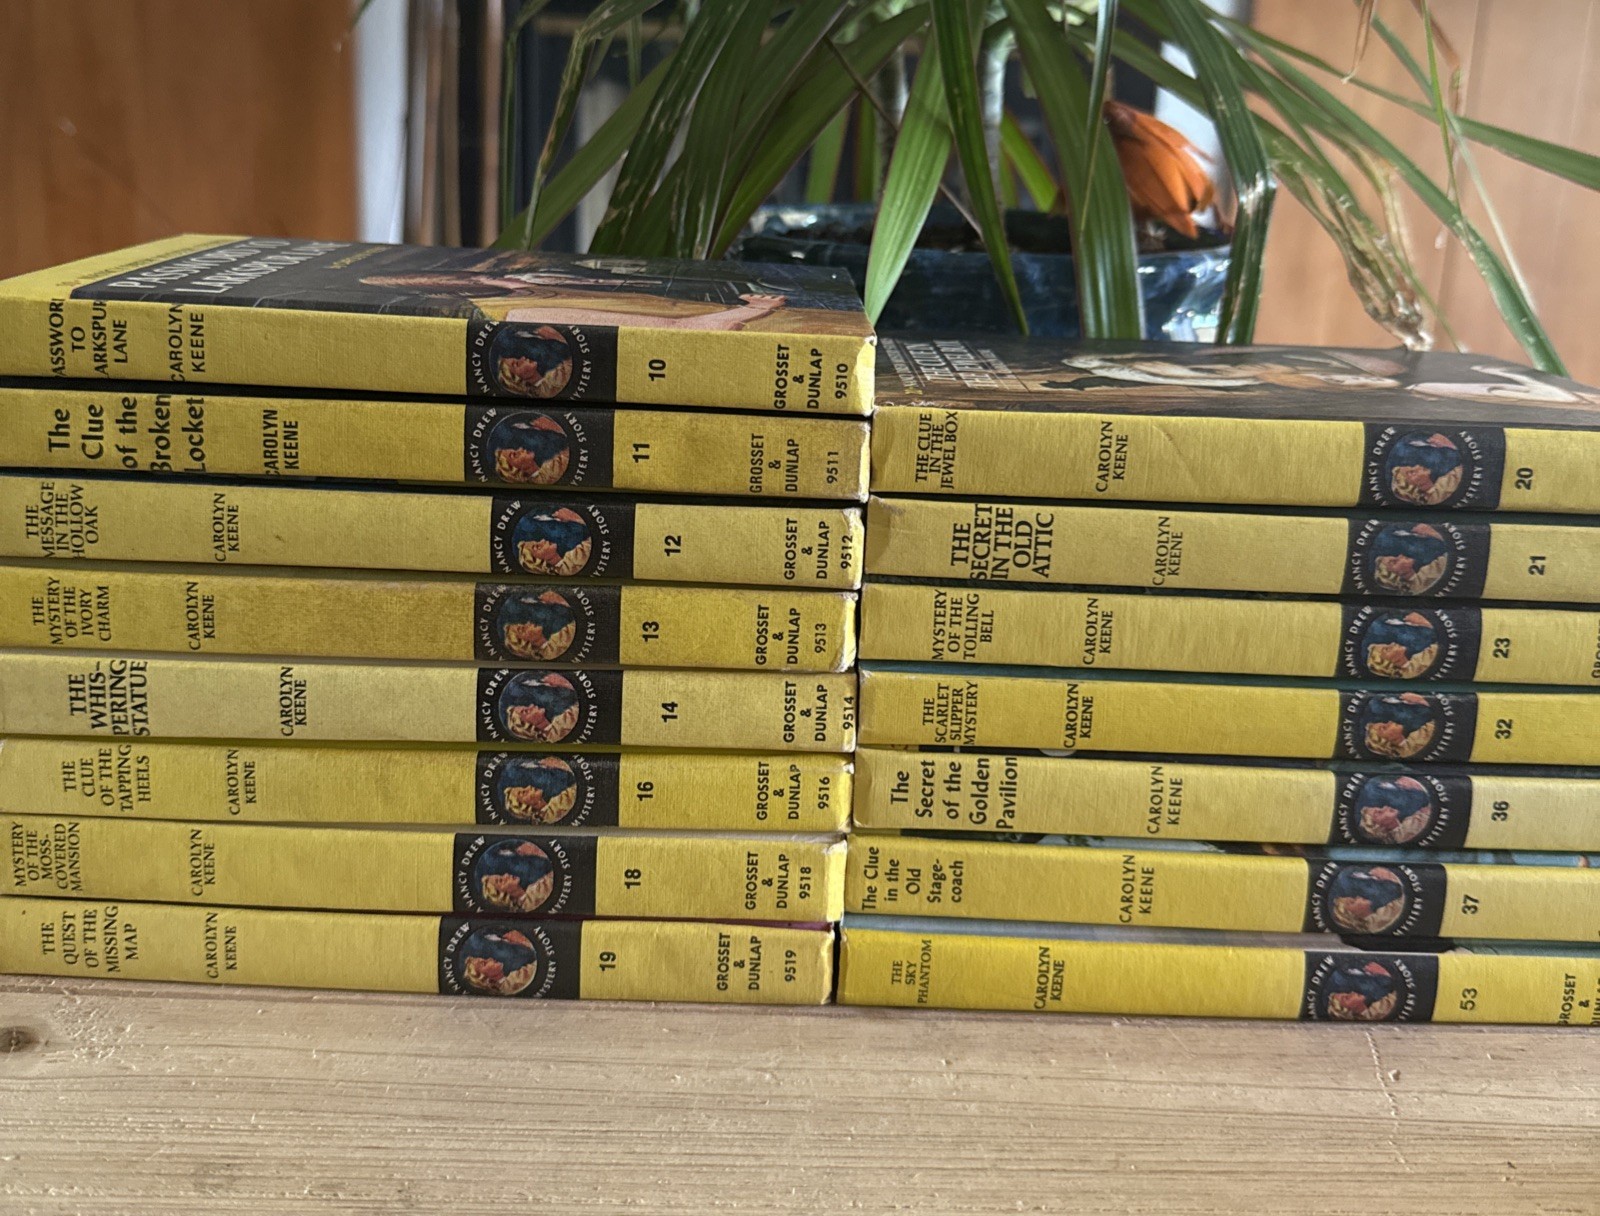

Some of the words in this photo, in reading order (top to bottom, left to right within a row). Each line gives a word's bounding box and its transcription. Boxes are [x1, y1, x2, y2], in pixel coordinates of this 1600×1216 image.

[71, 326, 86, 353] TO
[114, 319, 128, 364] LANE
[191, 312, 205, 372] KEENE
[648, 359, 666, 382] 10
[774, 344, 789, 409] GROSSET
[807, 348, 823, 409] DUNLAP
[835, 363, 848, 399] 9510
[48, 408, 70, 452] The
[81, 404, 104, 460] Clue
[116, 396, 137, 436] the
[148, 394, 172, 473] Broken
[182, 398, 206, 472] Locket
[917, 413, 932, 451] CLUE
[944, 411, 958, 443] BOX
[115, 443, 138, 469] of
[284, 420, 300, 470] KEENE
[632, 443, 650, 463] 11
[930, 424, 944, 454] THE
[1095, 421, 1113, 492] CAROLYN
[1112, 434, 1128, 480] KEENE
[750, 433, 764, 493] GROSSET
[785, 438, 799, 492] DUNLAP
[827, 452, 839, 484] 9511
[915, 453, 929, 483] THE
[929, 457, 941, 474] IN
[940, 445, 956, 489] JEWEL
[1515, 467, 1534, 490] 20
[26, 505, 39, 539] THE
[56, 493, 69, 529] THE
[85, 505, 99, 544] OAK
[214, 493, 226, 562] CAROLYN
[228, 504, 240, 552] KEENE
[498, 500, 522, 530] DREW
[586, 504, 610, 534] STORY
[994, 508, 1014, 550] THE
[56, 532, 69, 550] IN
[494, 535, 512, 573] NANCY
[664, 535, 682, 556] 12
[784, 518, 798, 580] GROSSET
[816, 521, 830, 579] DUNLAP
[840, 535, 853, 569] 9512
[951, 522, 971, 566] THE
[970, 503, 992, 580] SECRET
[1012, 520, 1033, 569] OLD
[1032, 513, 1054, 578] ATTIC
[1152, 516, 1170, 586] CAROLYN
[1168, 532, 1183, 576] KEENE
[990, 558, 1010, 580] IN
[1528, 554, 1546, 576] 21
[32, 597, 45, 626] THE
[48, 577, 63, 644] MYSTERY
[64, 586, 76, 615] THE
[80, 590, 94, 636] IVORY
[97, 586, 111, 642] CHARM
[186, 581, 201, 650] CAROLYN
[202, 594, 216, 639] KEENE
[949, 597, 963, 628] THE
[64, 617, 77, 638] OF
[642, 621, 660, 642] 13
[755, 604, 769, 665] GROSSET
[787, 608, 800, 664] DUNLAP
[815, 623, 827, 653] 9513
[932, 589, 948, 660] MYSTERY
[948, 632, 961, 653] OF
[963, 593, 980, 660] TOLLING
[980, 610, 994, 644] BELL
[1082, 598, 1099, 666] CAROLYN
[1099, 610, 1114, 654] KEENE
[1493, 637, 1511, 659] 23
[68, 673, 87, 716] THE
[89, 661, 108, 729] WHIS-
[110, 659, 130, 736] PERING
[131, 660, 150, 737] STATUE
[280, 666, 294, 737] CAROLYN
[294, 679, 307, 726] KEENE
[661, 701, 679, 723] 14
[783, 681, 797, 743] GROSSET
[815, 684, 828, 741] DUNLAP
[843, 696, 855, 730] 9514
[922, 698, 935, 726] THE
[934, 683, 950, 743] SCARLET
[950, 687, 964, 740] SLIPPER
[963, 681, 978, 746] MYSTERY
[1063, 683, 1079, 748] CAROLYN
[1079, 696, 1094, 739] KEENE
[1494, 718, 1513, 740] 32
[62, 760, 76, 792] THE
[80, 758, 96, 797] CLUE
[99, 748, 112, 781] THE
[118, 744, 133, 812] TAPPING
[135, 755, 150, 802] HEELS
[226, 750, 240, 816] CAROLYN
[244, 761, 256, 804] KEENE
[942, 761, 962, 794] the
[100, 786, 115, 806] OF
[637, 780, 654, 801] 16
[756, 761, 770, 820] GROSSET
[788, 764, 801, 819] DUNLAP
[818, 777, 830, 809] 9516
[890, 770, 910, 805] The
[914, 760, 936, 818] Secret
[942, 799, 960, 820] of
[969, 758, 990, 825] Golden
[996, 757, 1018, 830] Pavilion
[1146, 766, 1164, 835] CAROLYN
[1166, 777, 1184, 826] KEENE
[1491, 800, 1510, 822] 36
[12, 822, 27, 887] MYSTERY
[26, 830, 38, 860] THE
[40, 833, 53, 879] MOSS-
[53, 823, 68, 890] COVERED
[68, 822, 83, 891] MANSION
[191, 829, 203, 897] CAROLYN
[203, 842, 216, 886] KEENE
[863, 846, 880, 880] Clue
[27, 862, 40, 881] OF
[624, 868, 642, 890] 18
[745, 851, 759, 910] GROSSET
[776, 854, 790, 909] DUNLAP
[799, 866, 812, 899] 9518
[884, 858, 900, 883] the
[905, 868, 921, 896] Old
[927, 858, 947, 904] Stage-
[950, 860, 964, 904] coach
[1119, 854, 1135, 924] CAROLYN
[1138, 866, 1155, 915] KEENE
[862, 886, 878, 911] The
[884, 886, 899, 902] in
[1462, 894, 1480, 915] 37
[41, 922, 55, 955] THE
[62, 911, 79, 966] QUEST
[82, 909, 98, 944] THE
[104, 905, 121, 973] MISSING
[124, 922, 139, 960] MAP
[203, 912, 219, 979] CAROLYN
[224, 925, 238, 971] KEENE
[82, 948, 99, 968] OF
[599, 951, 617, 971] 19
[717, 932, 731, 991] GROSSET
[748, 936, 762, 990] DUNLAP
[785, 950, 797, 982] 9519
[891, 960, 903, 986] THE
[905, 960, 917, 986] SKY
[918, 939, 932, 1004] PHANTOM
[1034, 946, 1050, 1010] CAROLYN
[1050, 960, 1066, 1001] KEENE
[1459, 987, 1479, 1011] 53
